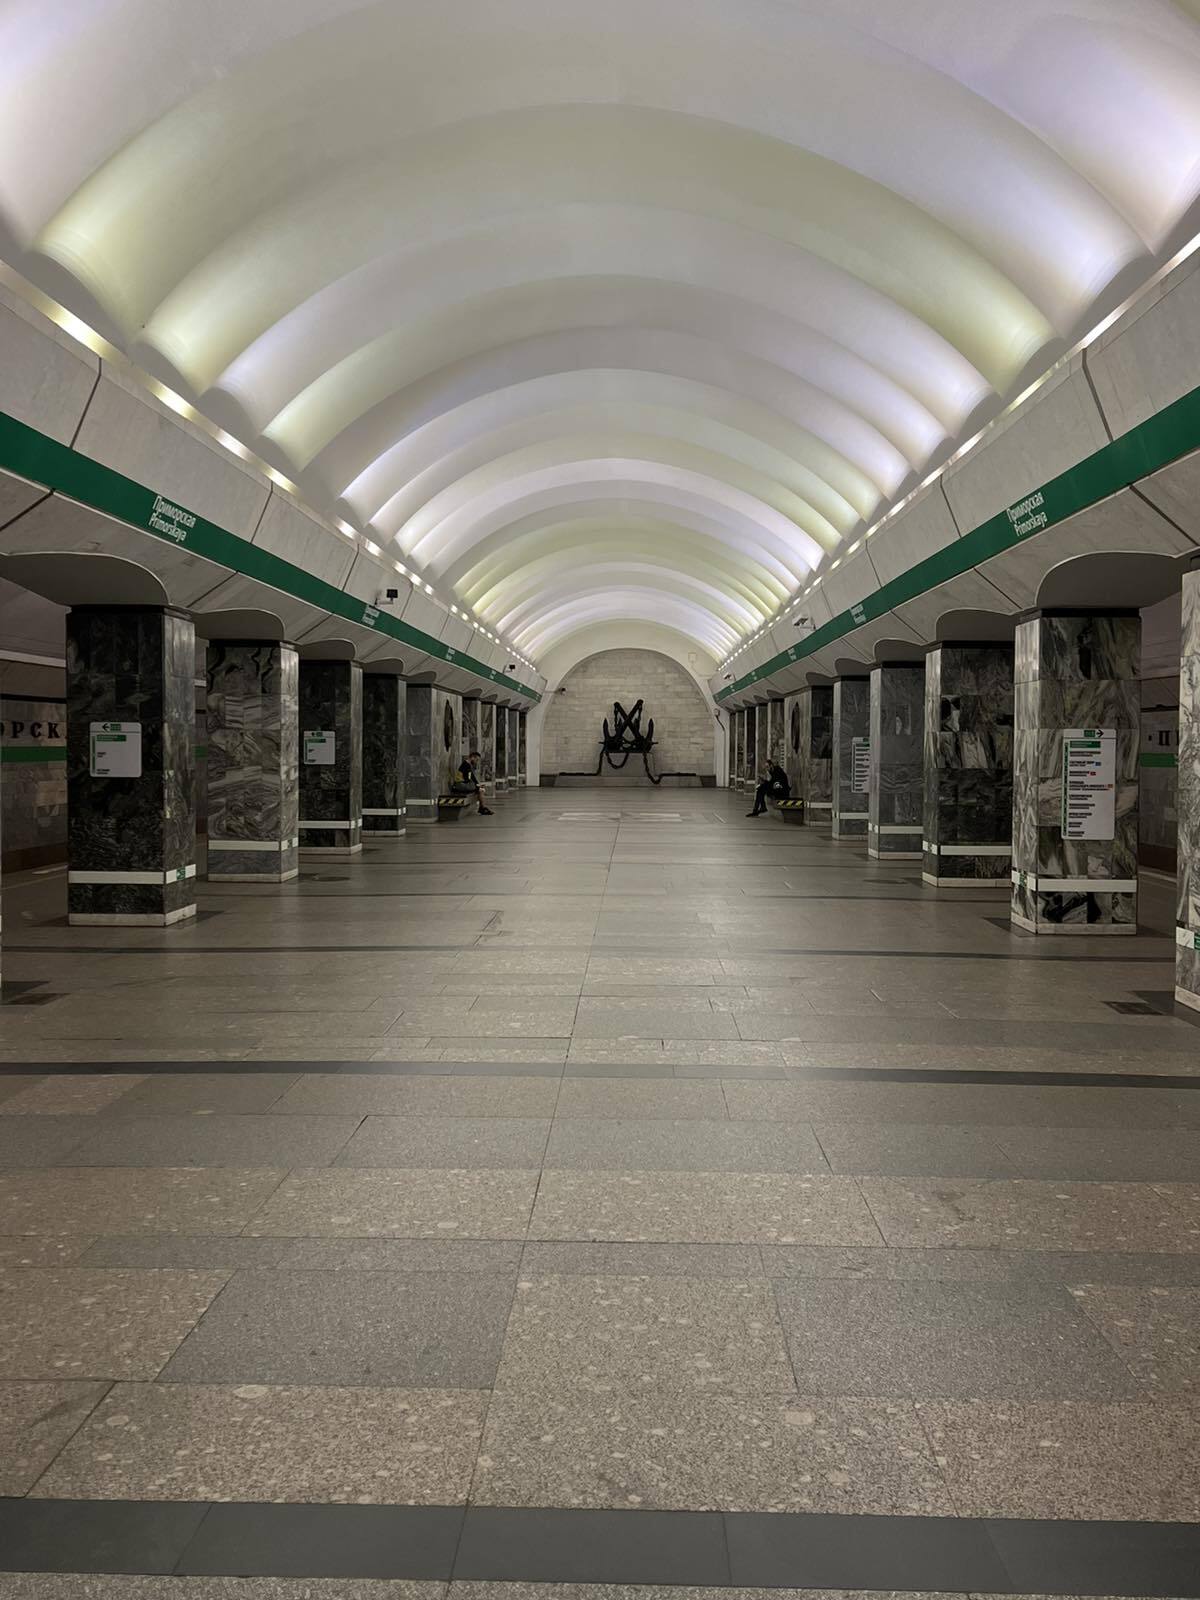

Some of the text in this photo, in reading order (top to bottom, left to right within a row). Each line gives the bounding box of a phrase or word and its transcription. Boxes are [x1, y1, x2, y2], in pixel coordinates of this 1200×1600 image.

[152, 495, 197, 528] Приморская
[1006, 491, 1045, 524] Приморская
[148, 512, 187, 542] Primorskaya
[1014, 511, 1048, 537] Primorskaya
[0, 720, 68, 739] РСК
